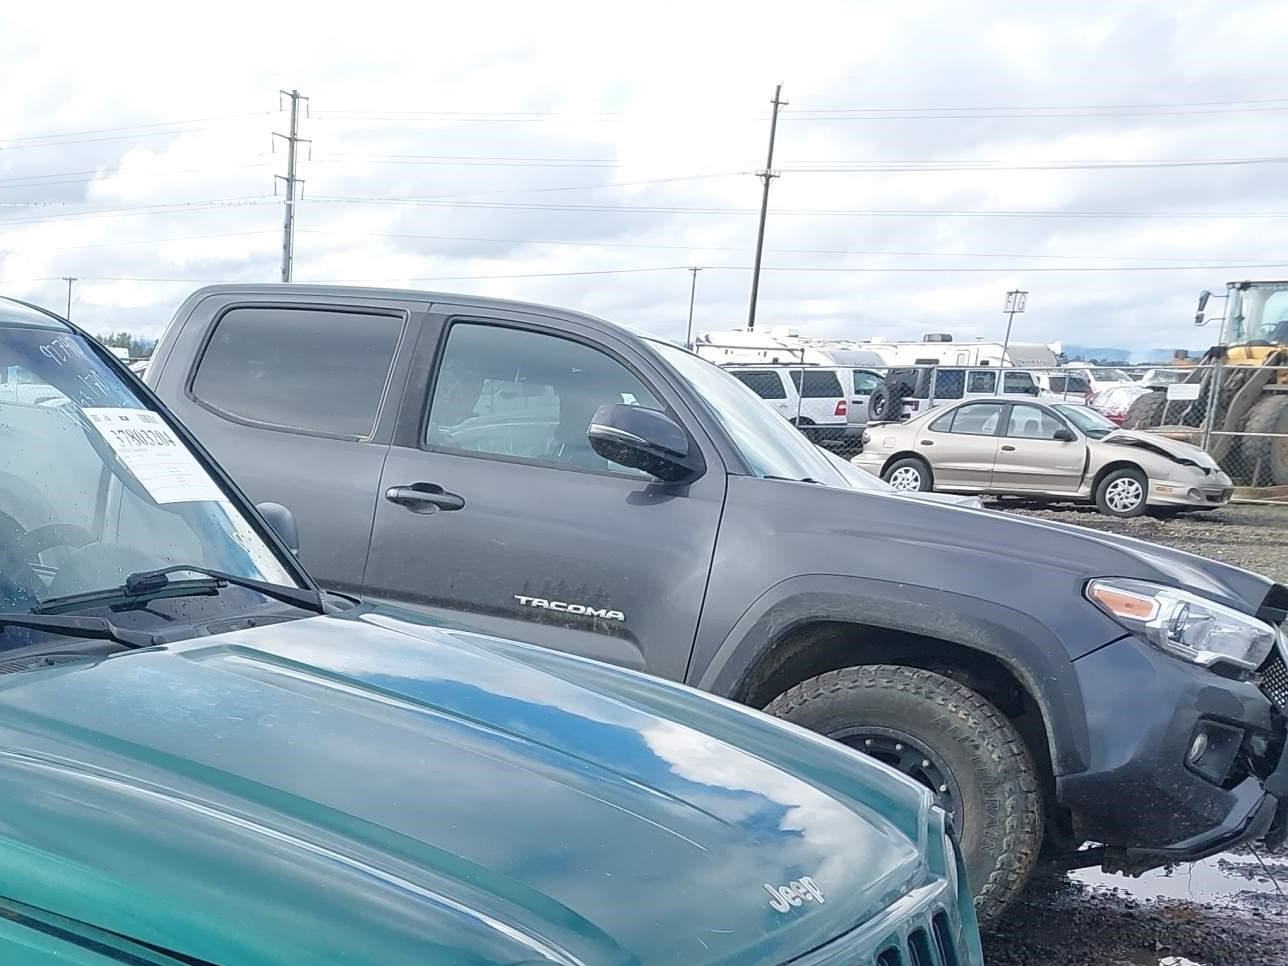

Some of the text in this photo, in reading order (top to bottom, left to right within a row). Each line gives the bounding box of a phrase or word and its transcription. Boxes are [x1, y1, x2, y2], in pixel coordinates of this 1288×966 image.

[110, 429, 176, 448] 37803204
[514, 595, 625, 621] TACOMA
[763, 876, 824, 913] Jeep
